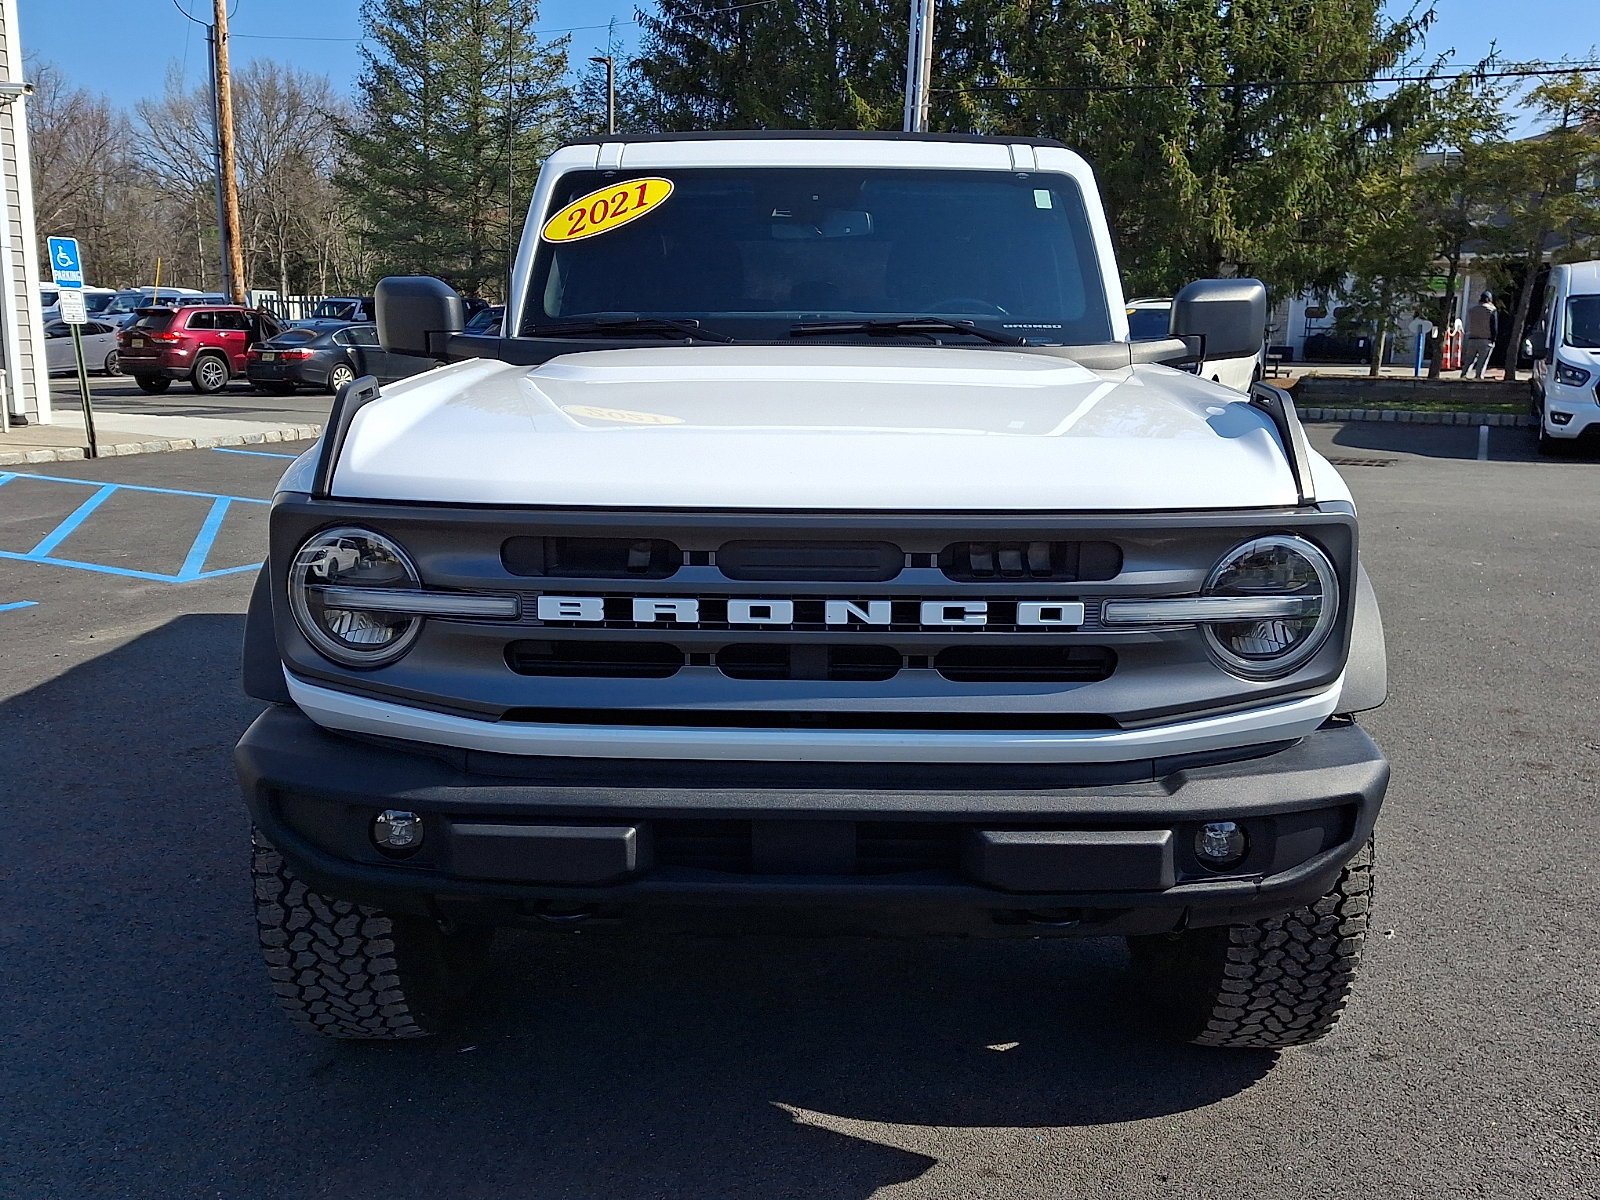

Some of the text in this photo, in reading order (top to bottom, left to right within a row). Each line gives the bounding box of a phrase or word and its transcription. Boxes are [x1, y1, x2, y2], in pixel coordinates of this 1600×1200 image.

[567, 183, 648, 236] 2021
[53, 270, 81, 280] PARKING
[537, 595, 1085, 625] BRONCO
